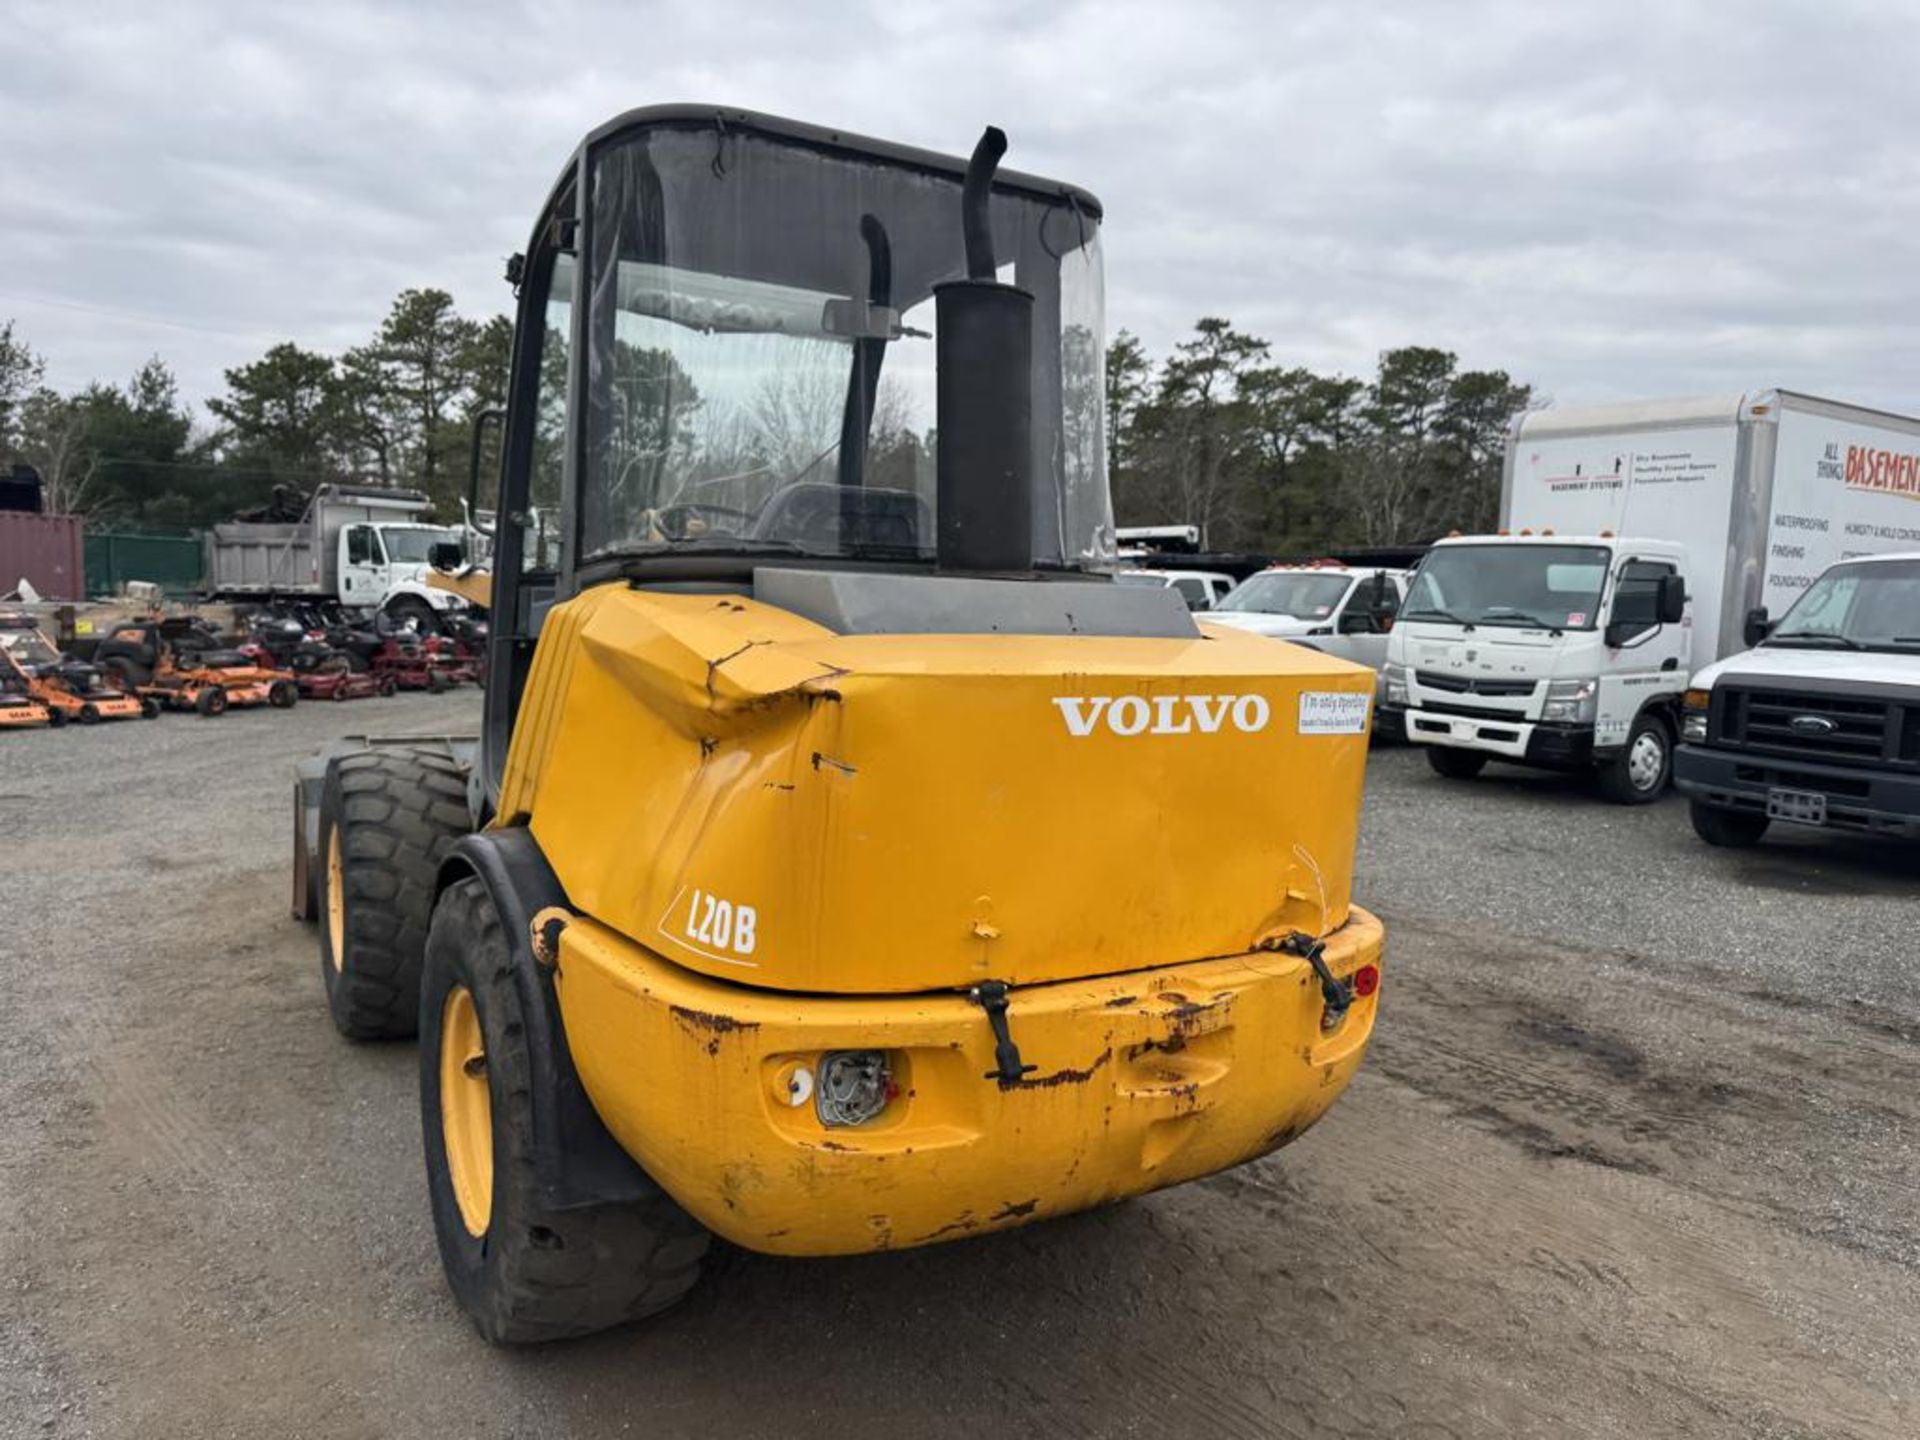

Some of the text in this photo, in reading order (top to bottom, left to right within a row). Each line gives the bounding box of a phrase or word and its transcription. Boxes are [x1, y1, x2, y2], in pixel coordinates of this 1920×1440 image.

[1845, 445, 1920, 493] BASEMEN
[1774, 514, 1829, 532] WATERPROOFING
[1771, 544, 1804, 558] FINISHING
[1052, 694, 1270, 736] VOLVO
[686, 888, 757, 954] L20B
